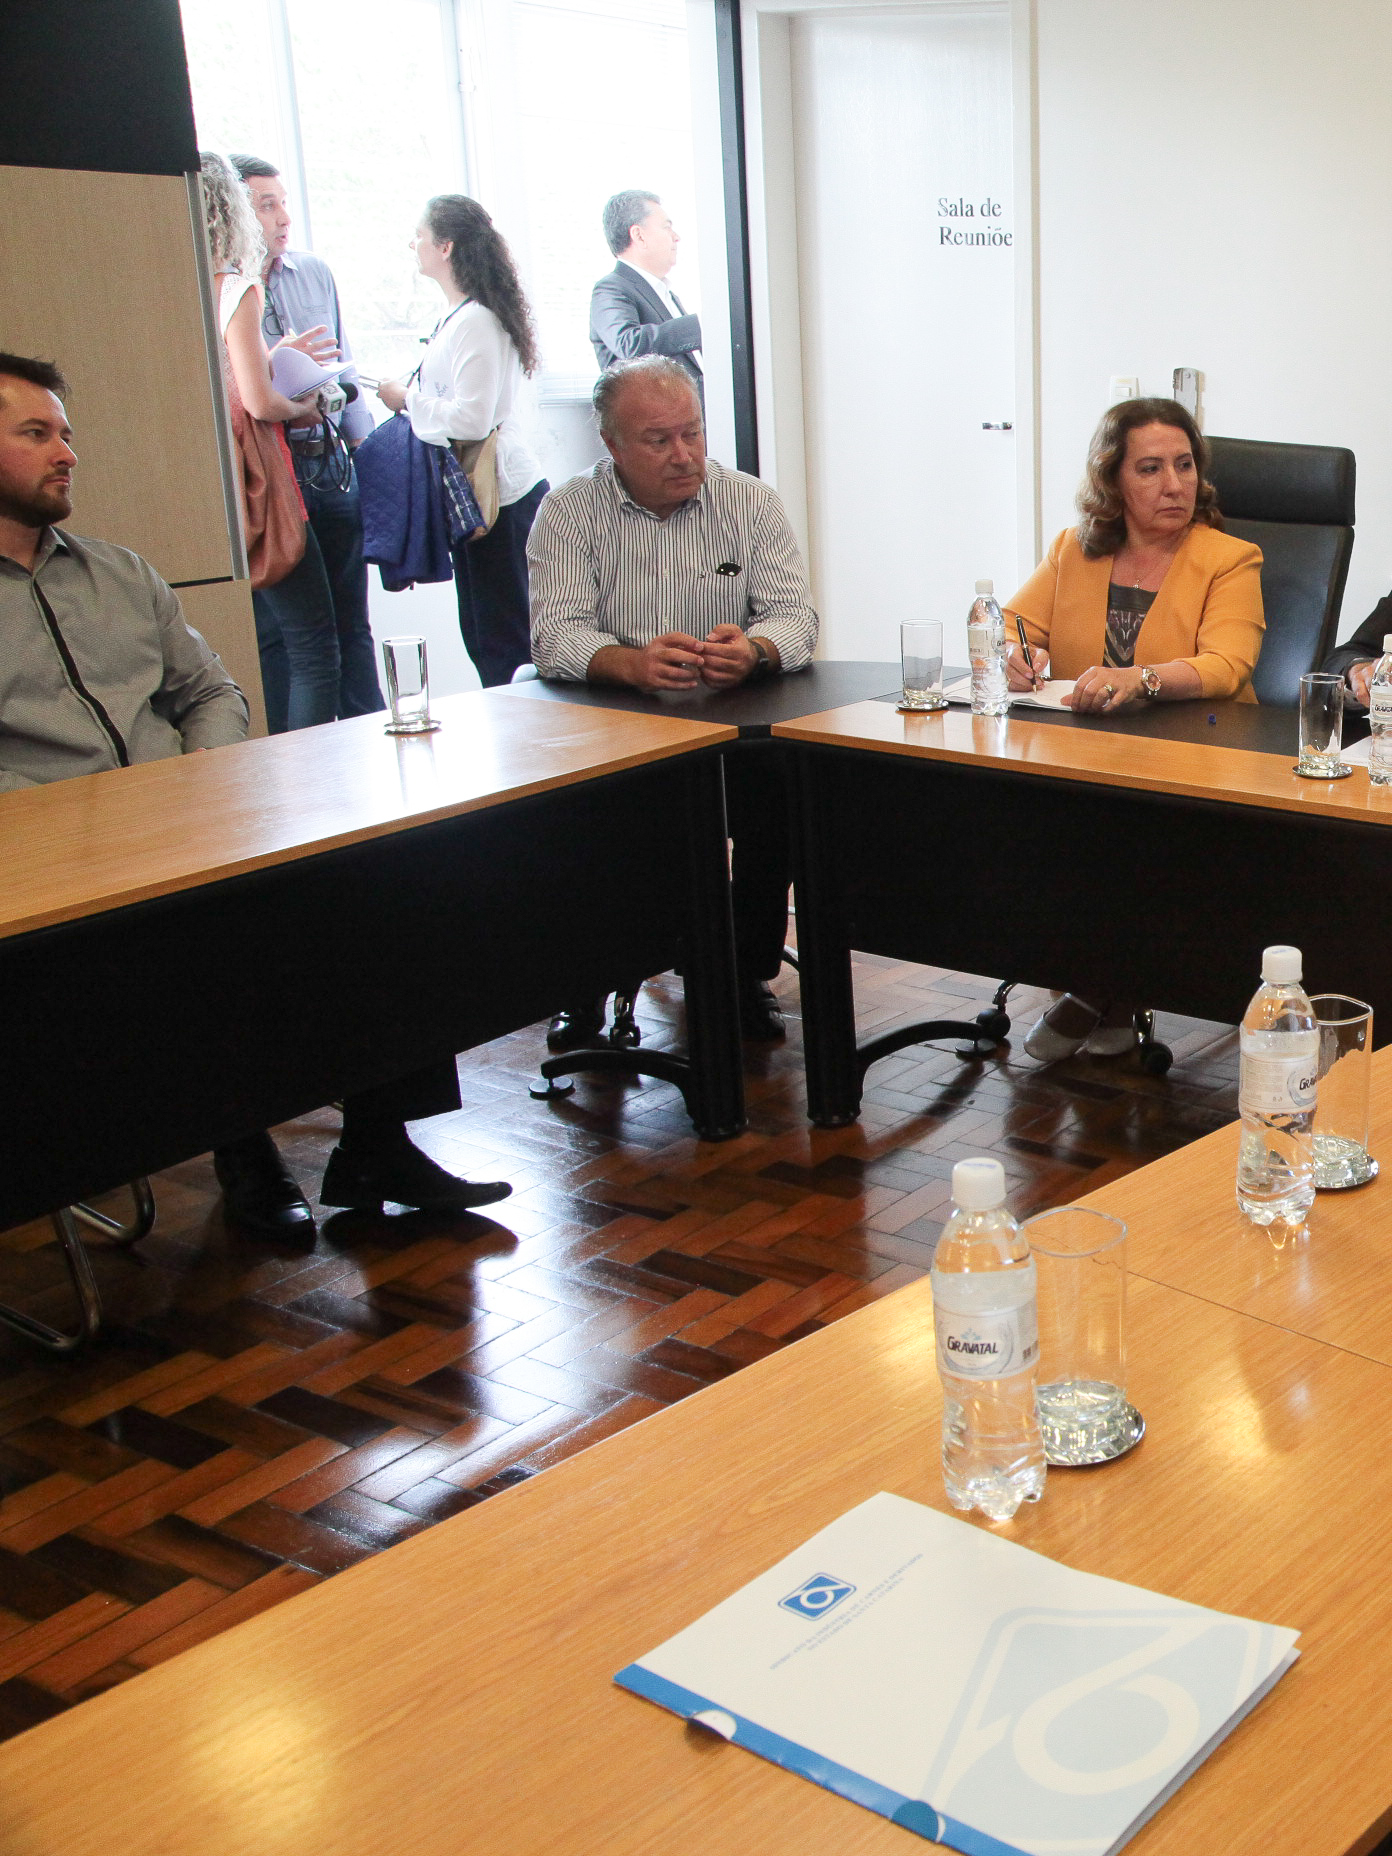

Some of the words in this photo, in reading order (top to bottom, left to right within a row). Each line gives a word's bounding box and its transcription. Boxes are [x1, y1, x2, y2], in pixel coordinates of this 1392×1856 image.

[938, 198, 974, 217] Sala
[980, 198, 1002, 217] de
[939, 226, 1013, 246] Reuniõe
[946, 1335, 999, 1355] GRAVATAL
